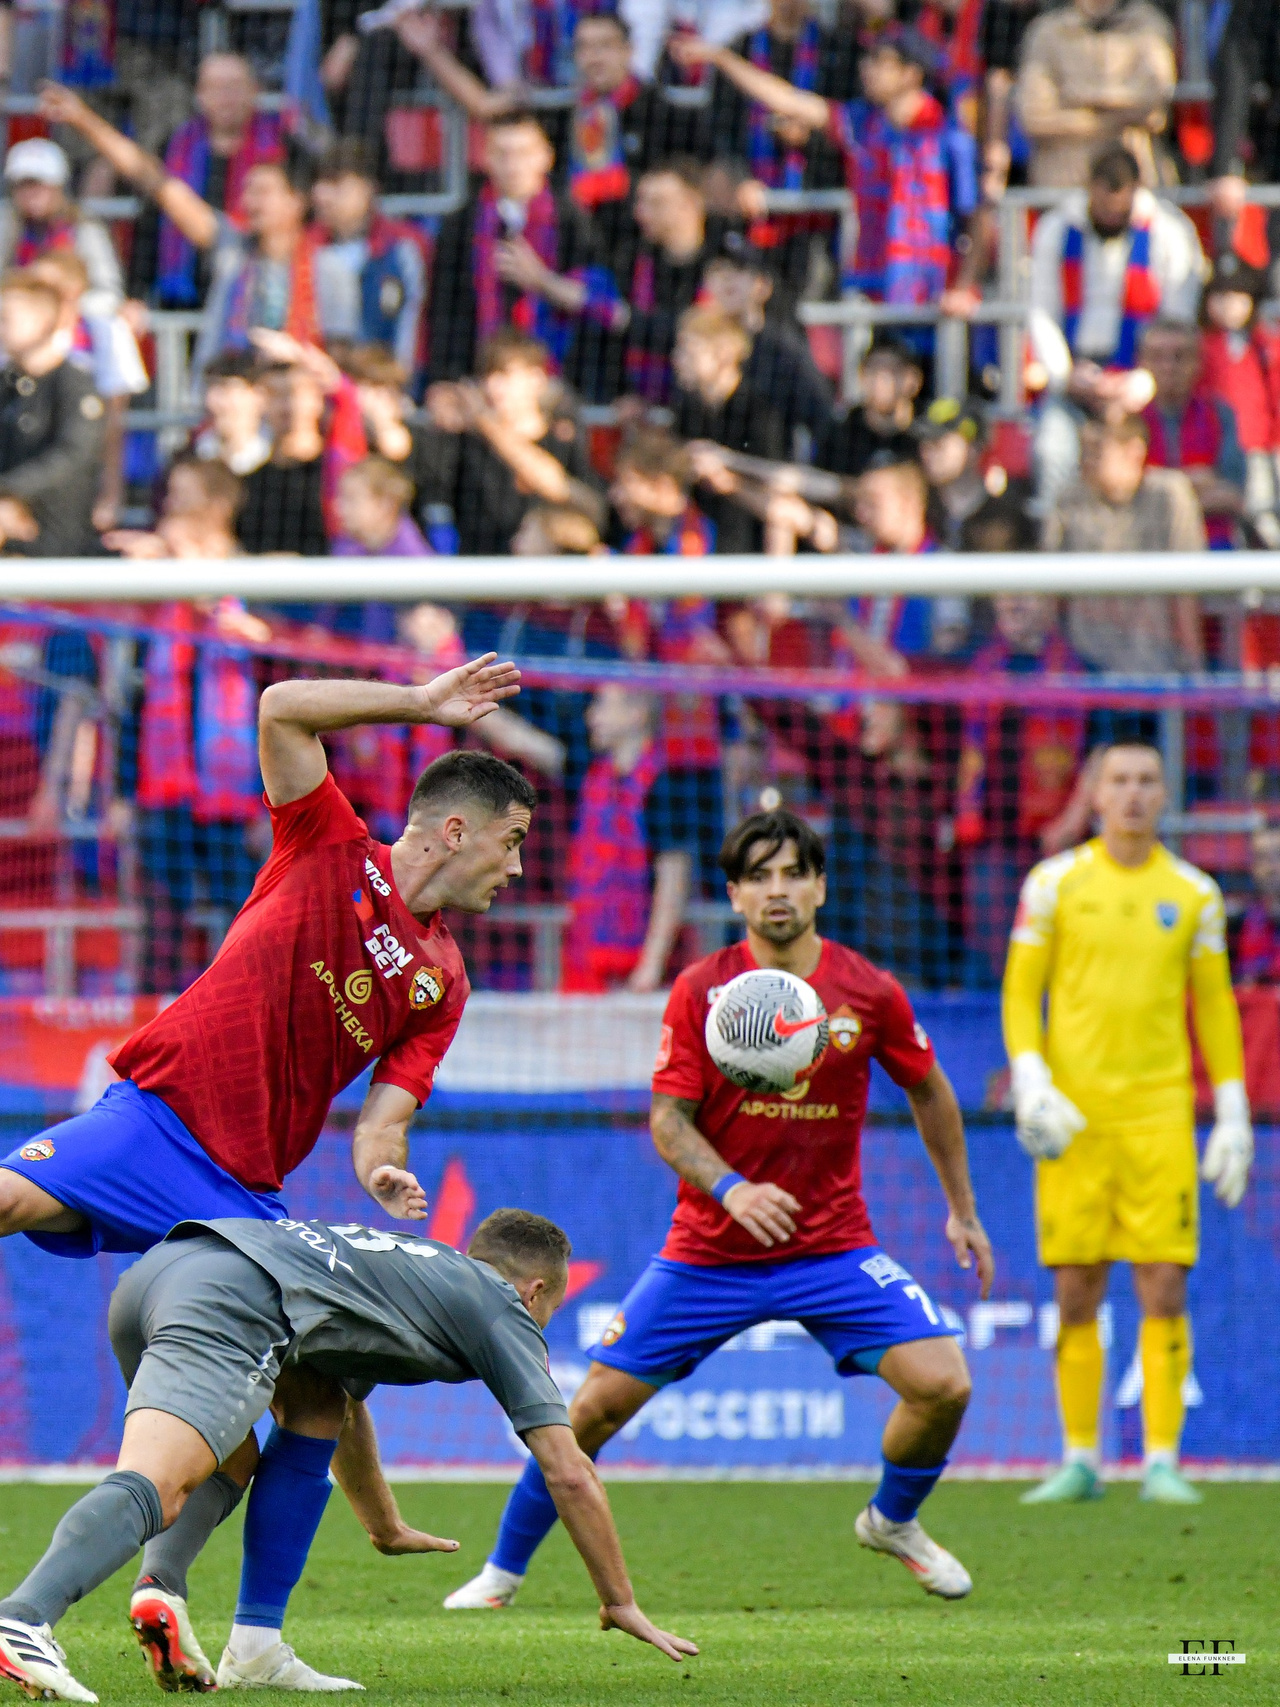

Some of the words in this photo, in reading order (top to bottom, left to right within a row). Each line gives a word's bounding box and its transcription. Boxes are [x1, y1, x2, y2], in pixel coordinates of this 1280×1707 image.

[364, 937, 403, 979] BET
[373, 923, 414, 969] FON
[739, 1100, 839, 1119] APOTHEKA
[902, 1284, 939, 1326] 7
